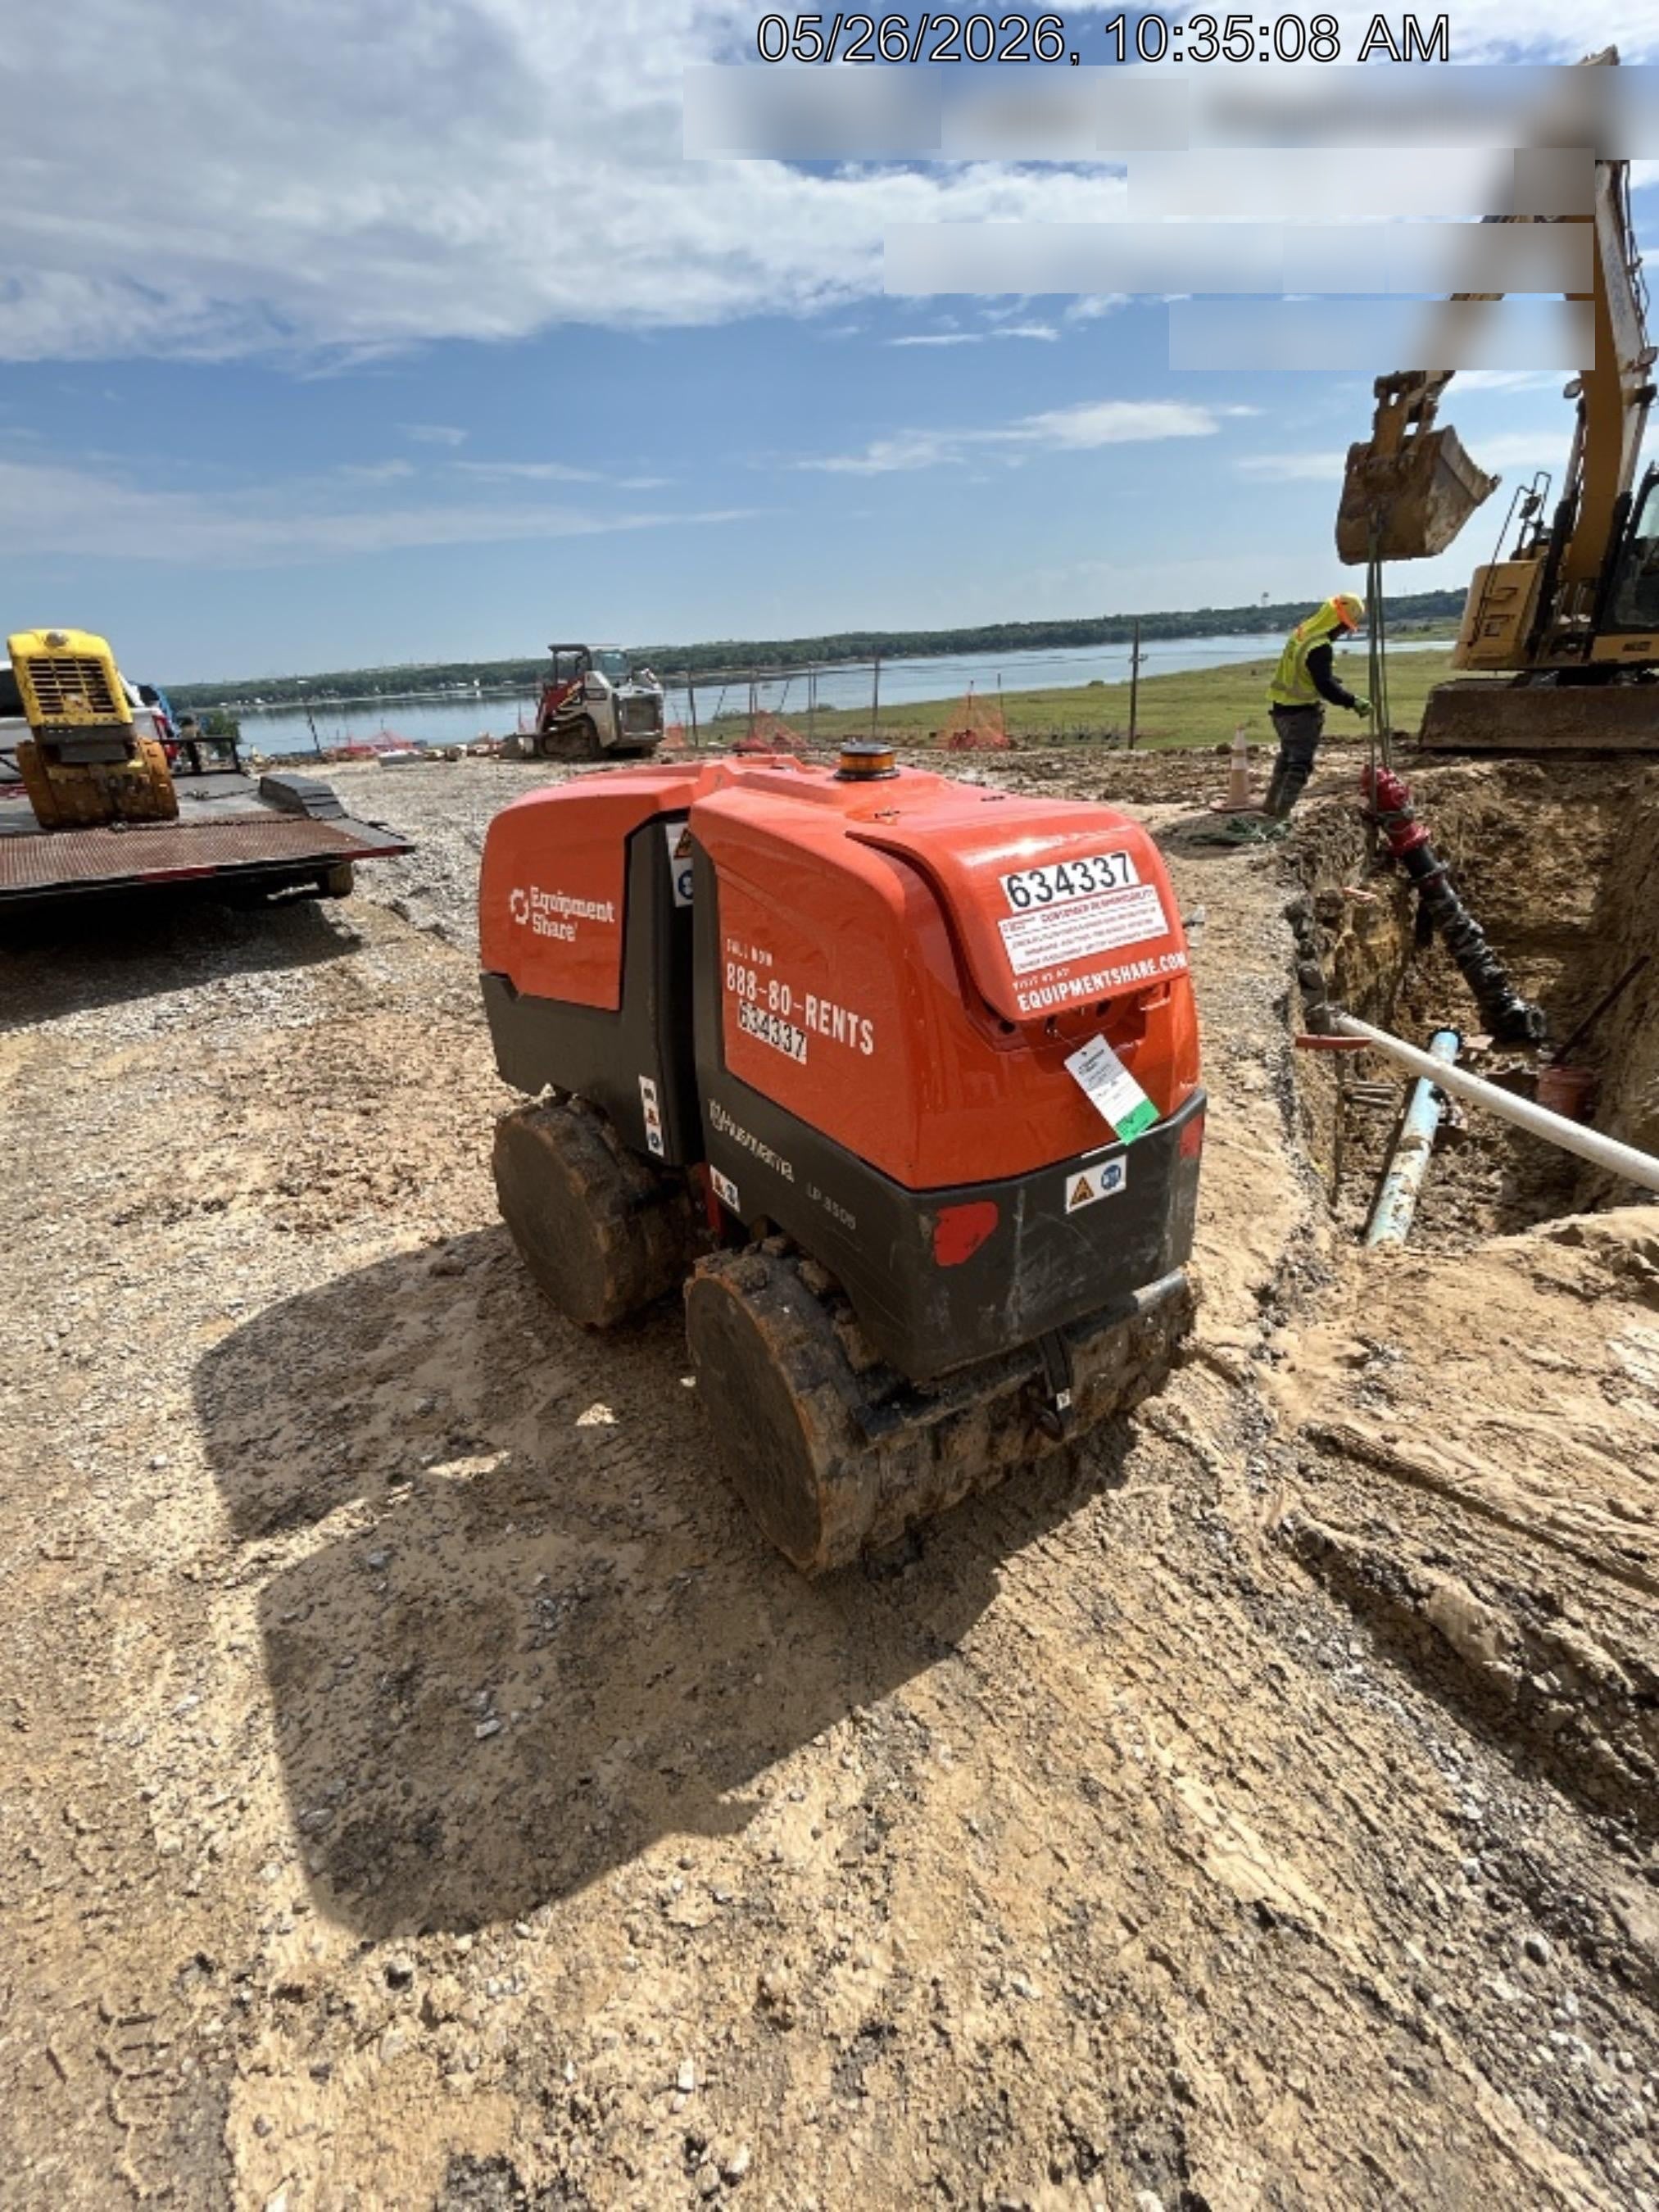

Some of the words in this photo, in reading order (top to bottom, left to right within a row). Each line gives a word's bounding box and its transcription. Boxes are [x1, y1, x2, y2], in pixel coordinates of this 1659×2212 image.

[530, 885, 615, 922] Equipment
[1006, 852, 1129, 908] 634337
[533, 911, 577, 942] Share
[727, 962, 874, 1055] 888-80-RENTS
[1017, 950, 1188, 1013] EQUIPMENTSHARE.COM
[739, 1001, 805, 1058] 634337
